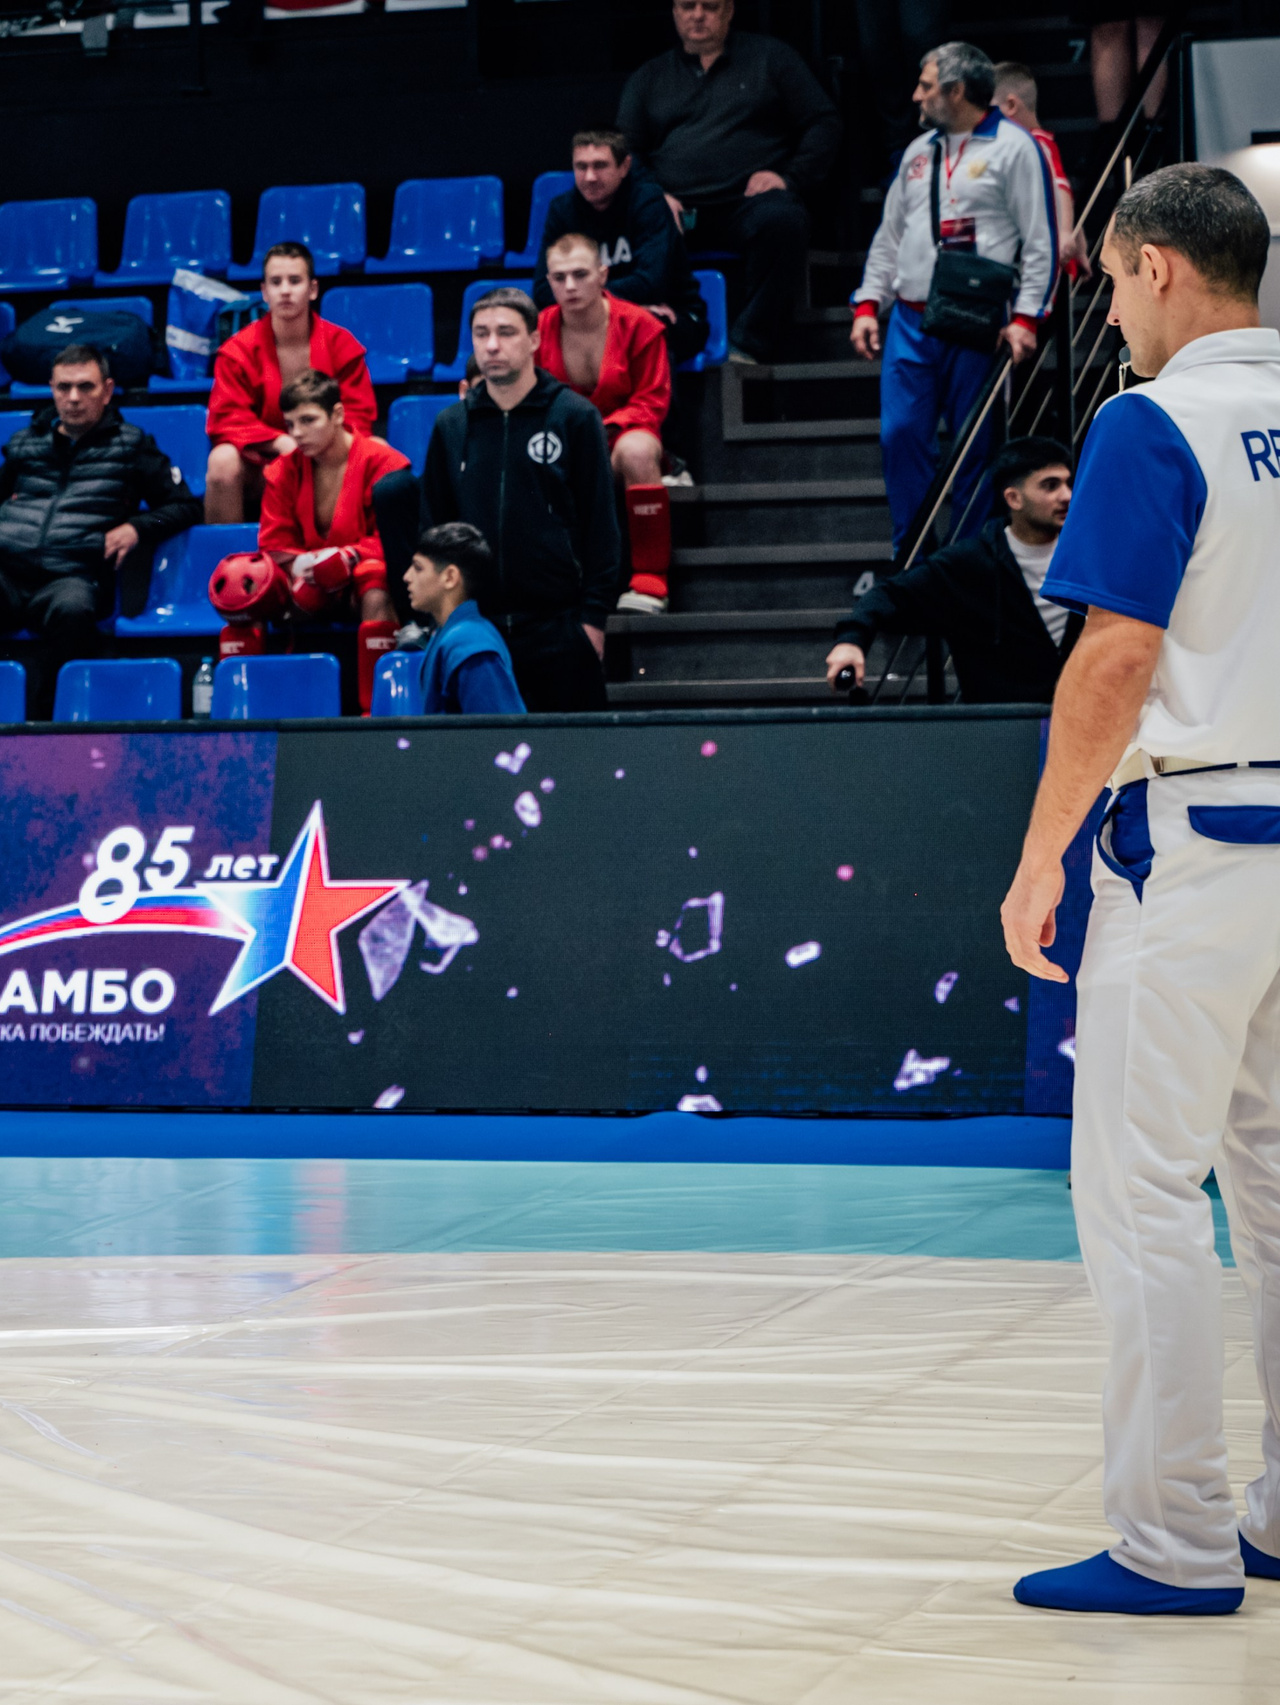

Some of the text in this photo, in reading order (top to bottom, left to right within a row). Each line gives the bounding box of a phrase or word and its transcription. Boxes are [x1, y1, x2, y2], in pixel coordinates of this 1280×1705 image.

[78, 825, 279, 924] 85 лет
[30, 1023, 165, 1045] ПОБЕЖДАТЬ!
